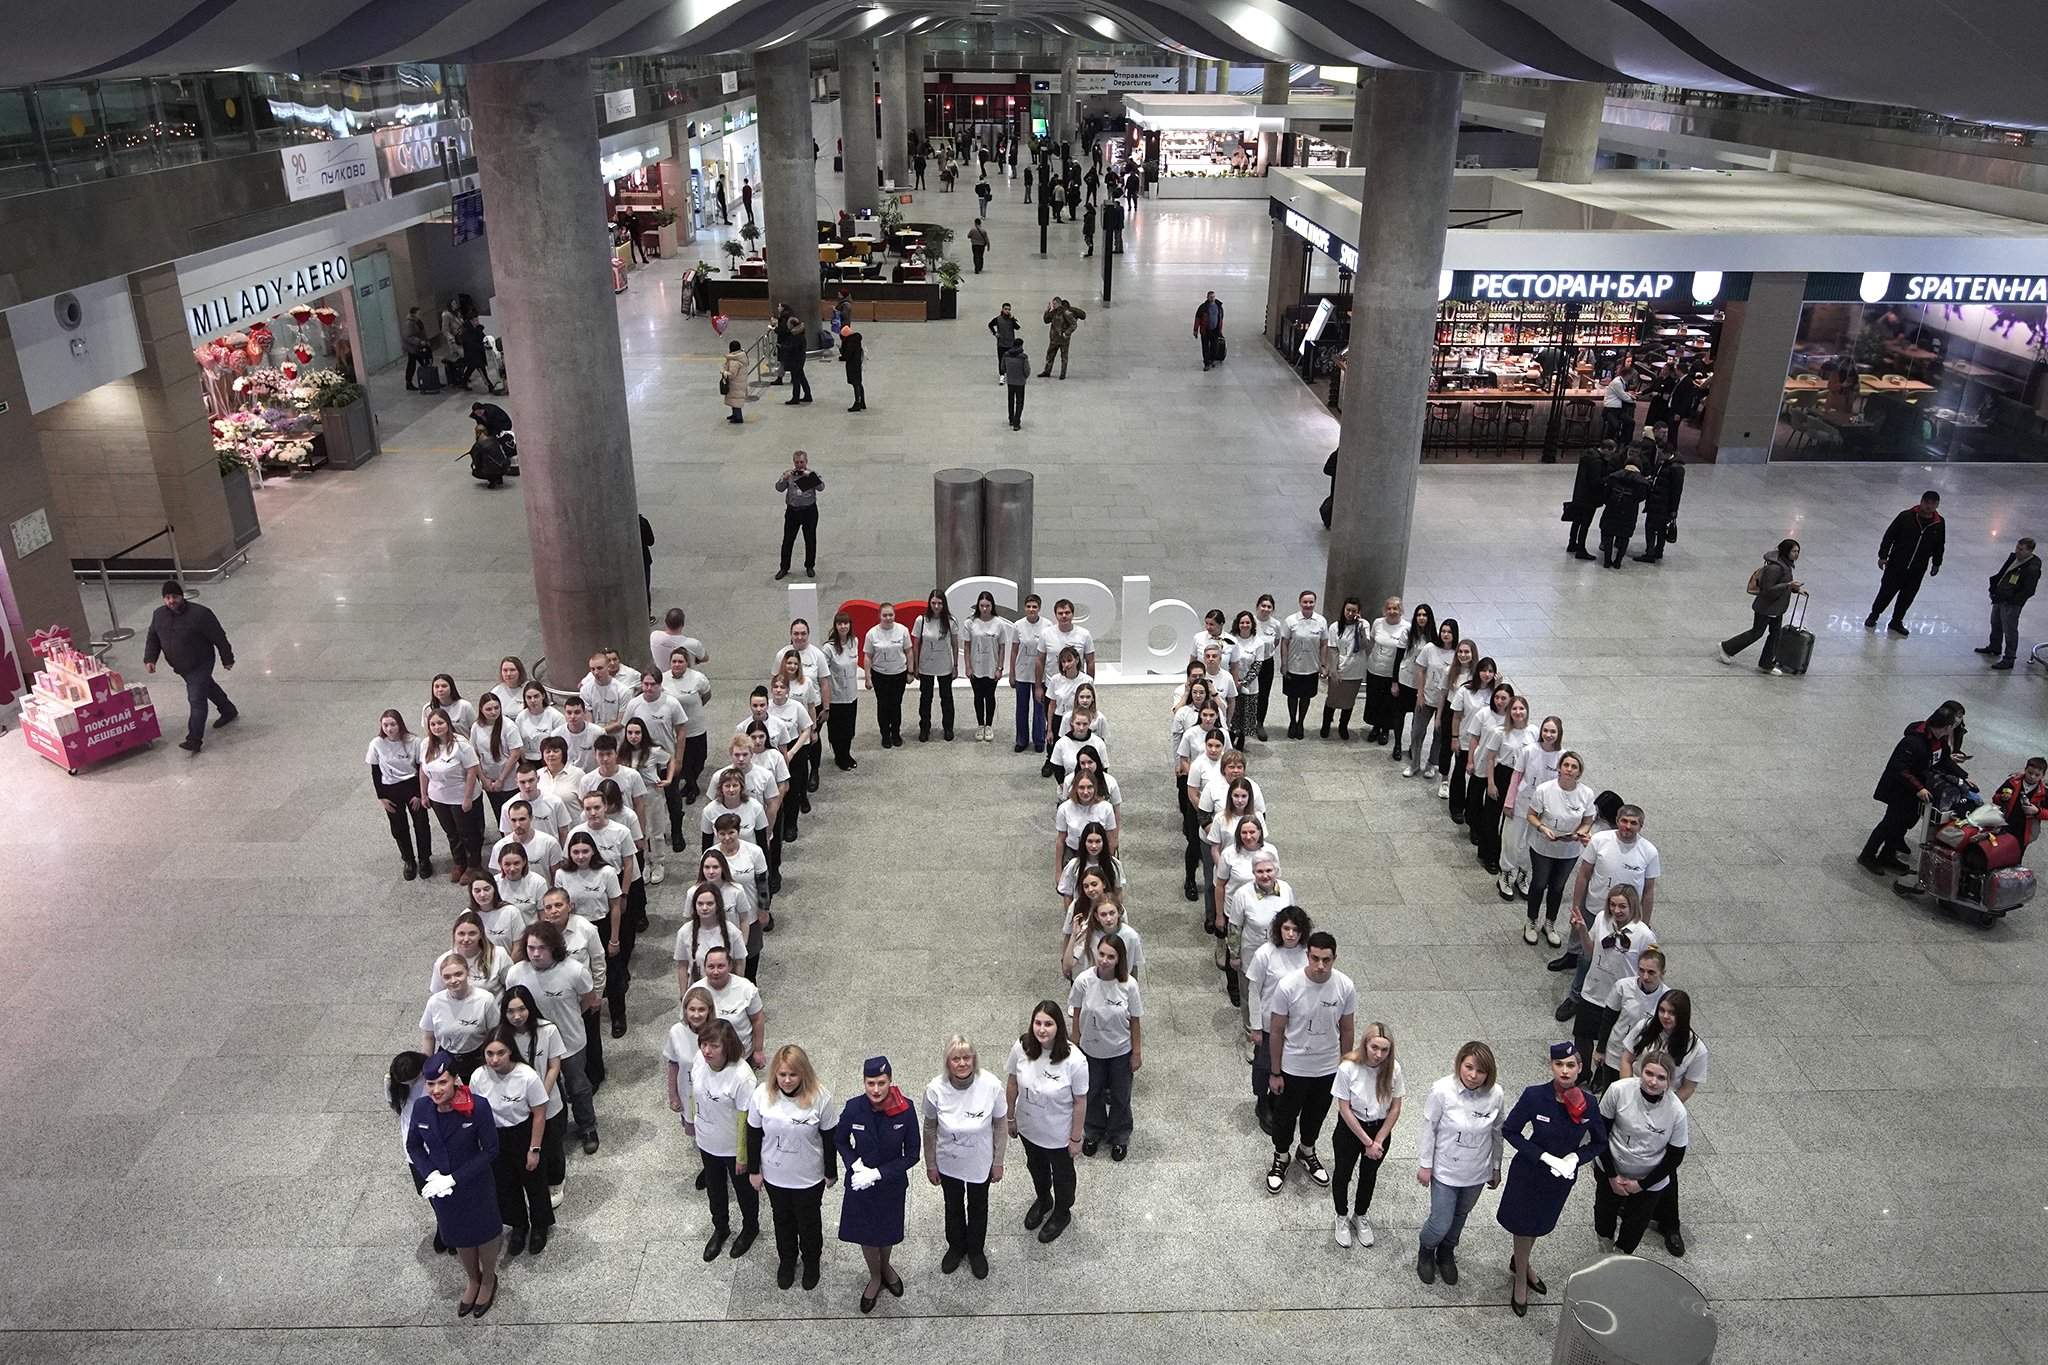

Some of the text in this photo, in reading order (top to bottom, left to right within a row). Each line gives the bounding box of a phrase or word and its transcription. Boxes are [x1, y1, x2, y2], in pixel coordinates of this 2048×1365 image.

[291, 153, 307, 176] 90
[321, 163, 366, 185] ПУЛКОВО
[192, 255, 348, 336] MILADY-AERO
[84, 708, 132, 733] ПОКУПАЙ
[87, 721, 137, 747] ДЕШЕВЛЕ
